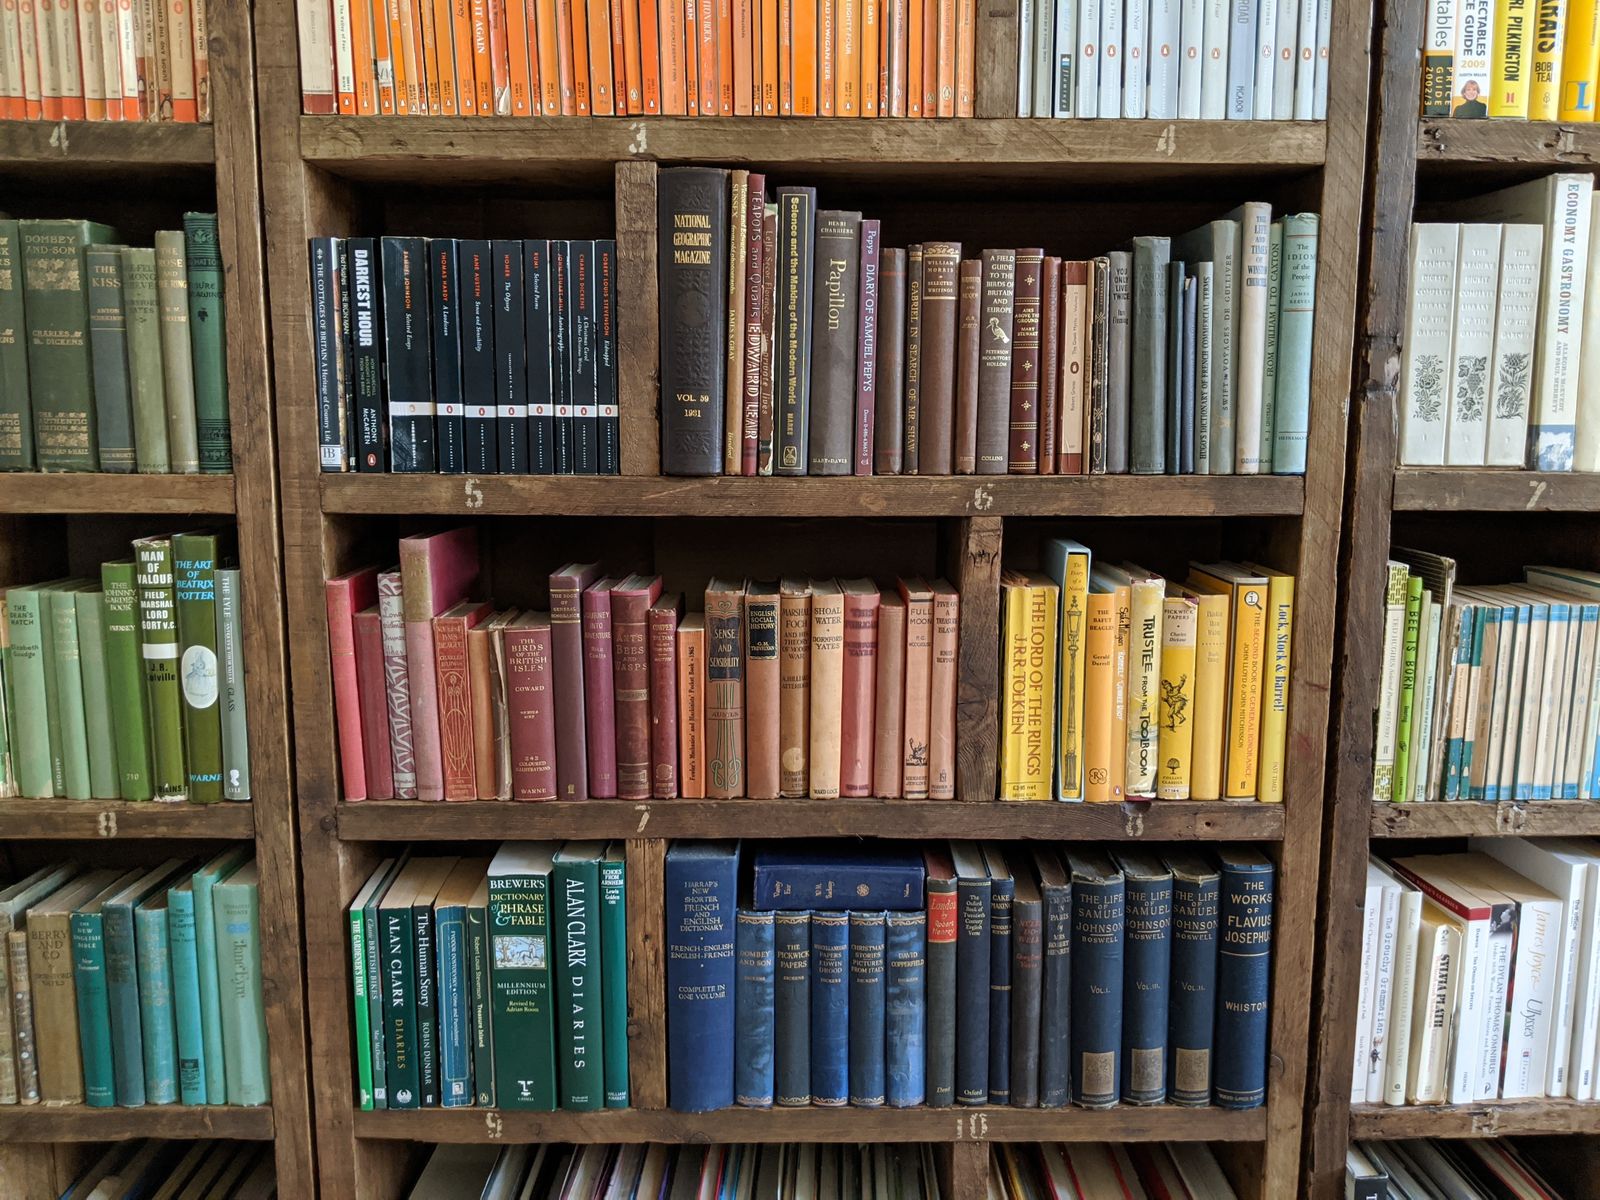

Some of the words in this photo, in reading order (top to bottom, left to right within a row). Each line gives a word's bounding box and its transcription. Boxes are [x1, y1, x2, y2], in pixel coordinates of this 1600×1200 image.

[476, 20, 486, 54] AGAIN
[1463, 15, 1475, 57] GUIDE
[1504, 16, 1523, 82] PILKINGTON
[1235, 85, 1244, 113] PICADOR
[1424, 66, 1434, 106] 2002/3
[1434, 66, 1444, 106] GUIDE
[1445, 66, 1453, 106] PRICE
[674, 214, 711, 229] NATIONAL
[750, 190, 762, 241] TEAPOTS
[789, 196, 800, 236] Science
[1563, 184, 1580, 244] ECONOMY
[25, 235, 76, 244] DOMBEY
[674, 231, 712, 247] GEOGRAPHIC
[789, 238, 799, 257] and
[865, 230, 876, 255] Pepys
[95, 266, 116, 274] THE
[316, 263, 324, 278] THE
[674, 250, 711, 265] MAGAZINE
[750, 247, 760, 268] and
[789, 258, 799, 273] the
[92, 278, 121, 288] KISS
[354, 249, 372, 311] DARKEST
[865, 264, 876, 297] DIARY
[986, 281, 1005, 289] BIRDS
[990, 272, 999, 280] TO
[1001, 272, 1014, 280] THE
[317, 279, 326, 319] COTTAGES
[749, 273, 762, 318] Quails
[788, 275, 799, 311] Making
[825, 258, 848, 332] Papillon
[910, 281, 919, 323] GABRIEL
[987, 289, 1014, 297] BRITAIN
[1557, 249, 1575, 335] GASTRONOMY
[788, 311, 799, 321] of
[864, 300, 875, 314] OF
[319, 320, 326, 330] OF
[359, 311, 373, 347] HOUR
[788, 322, 799, 339] the
[863, 316, 875, 359] SAMUEL
[910, 327, 918, 338] IN
[320, 331, 328, 361] BRITAIN
[603, 340, 611, 367] Kidnapped
[746, 322, 762, 397] EDWARD
[787, 340, 799, 375] Modern
[862, 361, 873, 392] PEPYS
[909, 345, 918, 383] SEARCH
[321, 368, 330, 396] Heritage
[787, 376, 798, 405] World
[908, 388, 917, 403] OF
[323, 404, 331, 429] Country
[370, 409, 378, 443] ANTHONY
[744, 401, 759, 440] LEAR
[908, 409, 916, 424] MR.
[907, 427, 916, 453] SHAW
[464, 477, 484, 509] 5
[1526, 480, 1547, 511] 7
[141, 551, 165, 562] MAN
[148, 562, 160, 573] OF
[175, 560, 193, 569] THE
[193, 560, 215, 569] ART
[138, 574, 174, 585] VALOUR
[177, 579, 215, 589] BEATRIX
[187, 570, 201, 579] OF
[141, 600, 174, 609] MARSHAL
[177, 591, 215, 601] POTTER
[1031, 591, 1046, 624] THE
[146, 610, 169, 619] LORD
[814, 607, 842, 615] SHOAL
[815, 616, 842, 625] WATER
[1276, 604, 1291, 632] Lock,
[1407, 611, 1419, 632] BEE
[142, 620, 162, 630] GORT
[714, 628, 736, 639] SENSE
[511, 644, 544, 652] BIRDS
[717, 644, 732, 653] AND
[1013, 633, 1027, 672] J.R.R.
[1029, 625, 1045, 668] LORD
[1142, 615, 1157, 673] TRUSTEE
[1275, 633, 1289, 663] Stock
[1406, 640, 1417, 651] IS
[509, 656, 548, 665] BRITISH
[513, 664, 545, 673] ISLES
[1275, 664, 1287, 674] &
[1028, 670, 1043, 692] OF
[1402, 661, 1416, 690] BORN
[1011, 672, 1027, 735] TOLKIEN
[1272, 676, 1287, 713] Barrel!
[1028, 697, 1043, 731] THE
[1026, 731, 1041, 777] RINGS
[1139, 712, 1152, 777] TOOLROOM
[634, 803, 652, 833] 7
[490, 879, 545, 889] BREWER'S
[491, 893, 545, 901] DICTIONARY
[1244, 881, 1265, 891] THE
[500, 903, 545, 913] PHRASE
[566, 879, 585, 918] ALAN
[1080, 893, 1099, 903] THE
[1104, 893, 1123, 904] LIFE
[1231, 893, 1272, 905] WORKS
[417, 913, 429, 935] The
[495, 911, 511, 926] &
[511, 915, 546, 926] FABLE
[1078, 908, 1123, 919] SAMUEL
[1228, 915, 1272, 928] FLAVIUS
[388, 916, 402, 954] ALAN
[1076, 922, 1124, 933] JOHNSON
[418, 937, 430, 978] Human
[567, 921, 587, 968] CLARK
[1380, 932, 1393, 973] Grouchy
[390, 959, 404, 1007] CLARK
[497, 982, 546, 990] MILLENNIUM
[1436, 954, 1451, 992] SYLVIA
[418, 979, 432, 1007] Story
[1225, 1001, 1268, 1012] WHISTON
[1376, 977, 1389, 1035] Grammarian
[572, 976, 586, 1069] DIARIES
[1433, 993, 1446, 1028] PLATH
[1520, 998, 1543, 1040] Ulysses
[394, 1019, 406, 1070] DIARIES
[422, 1022, 430, 1048] ROBIN
[423, 1050, 432, 1085] DUNBAR
